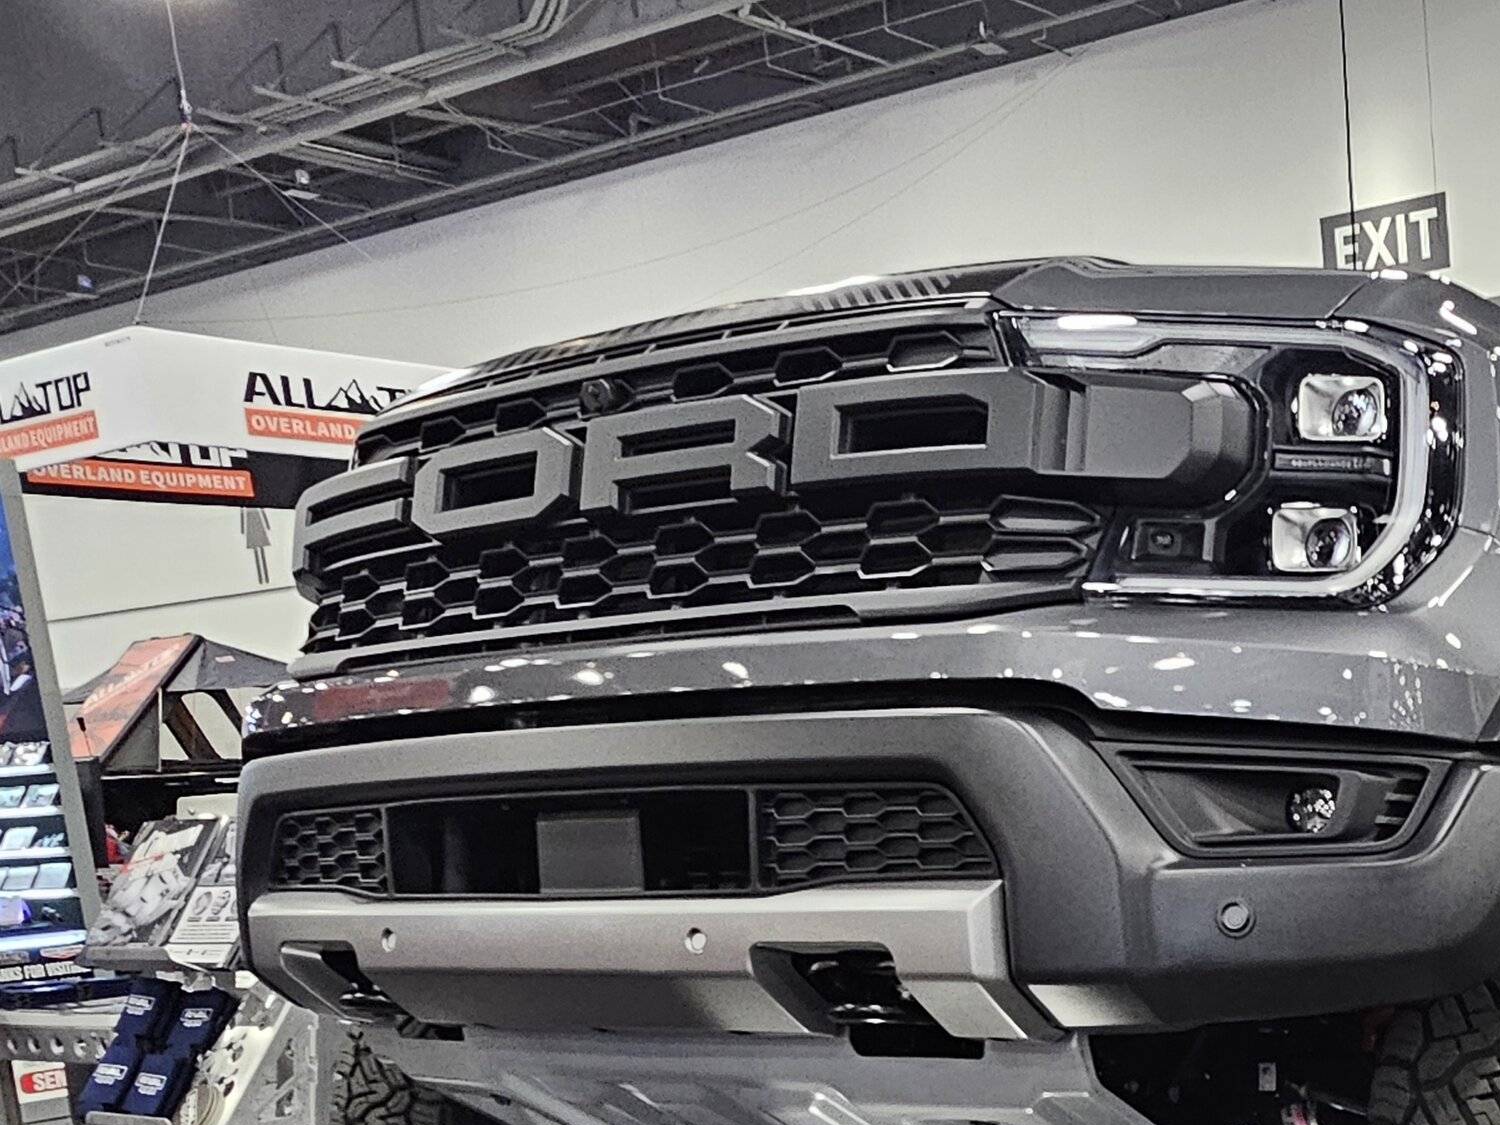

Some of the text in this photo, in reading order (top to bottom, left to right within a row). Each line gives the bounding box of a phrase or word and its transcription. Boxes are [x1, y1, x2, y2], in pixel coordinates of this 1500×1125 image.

[1334, 206, 1438, 271] EXIT
[30, 415, 96, 448] EQUIPMENT
[251, 414, 356, 440] OVERLAND
[140, 469, 246, 490] EQUIPMENT
[294, 366, 1042, 594] FORD
